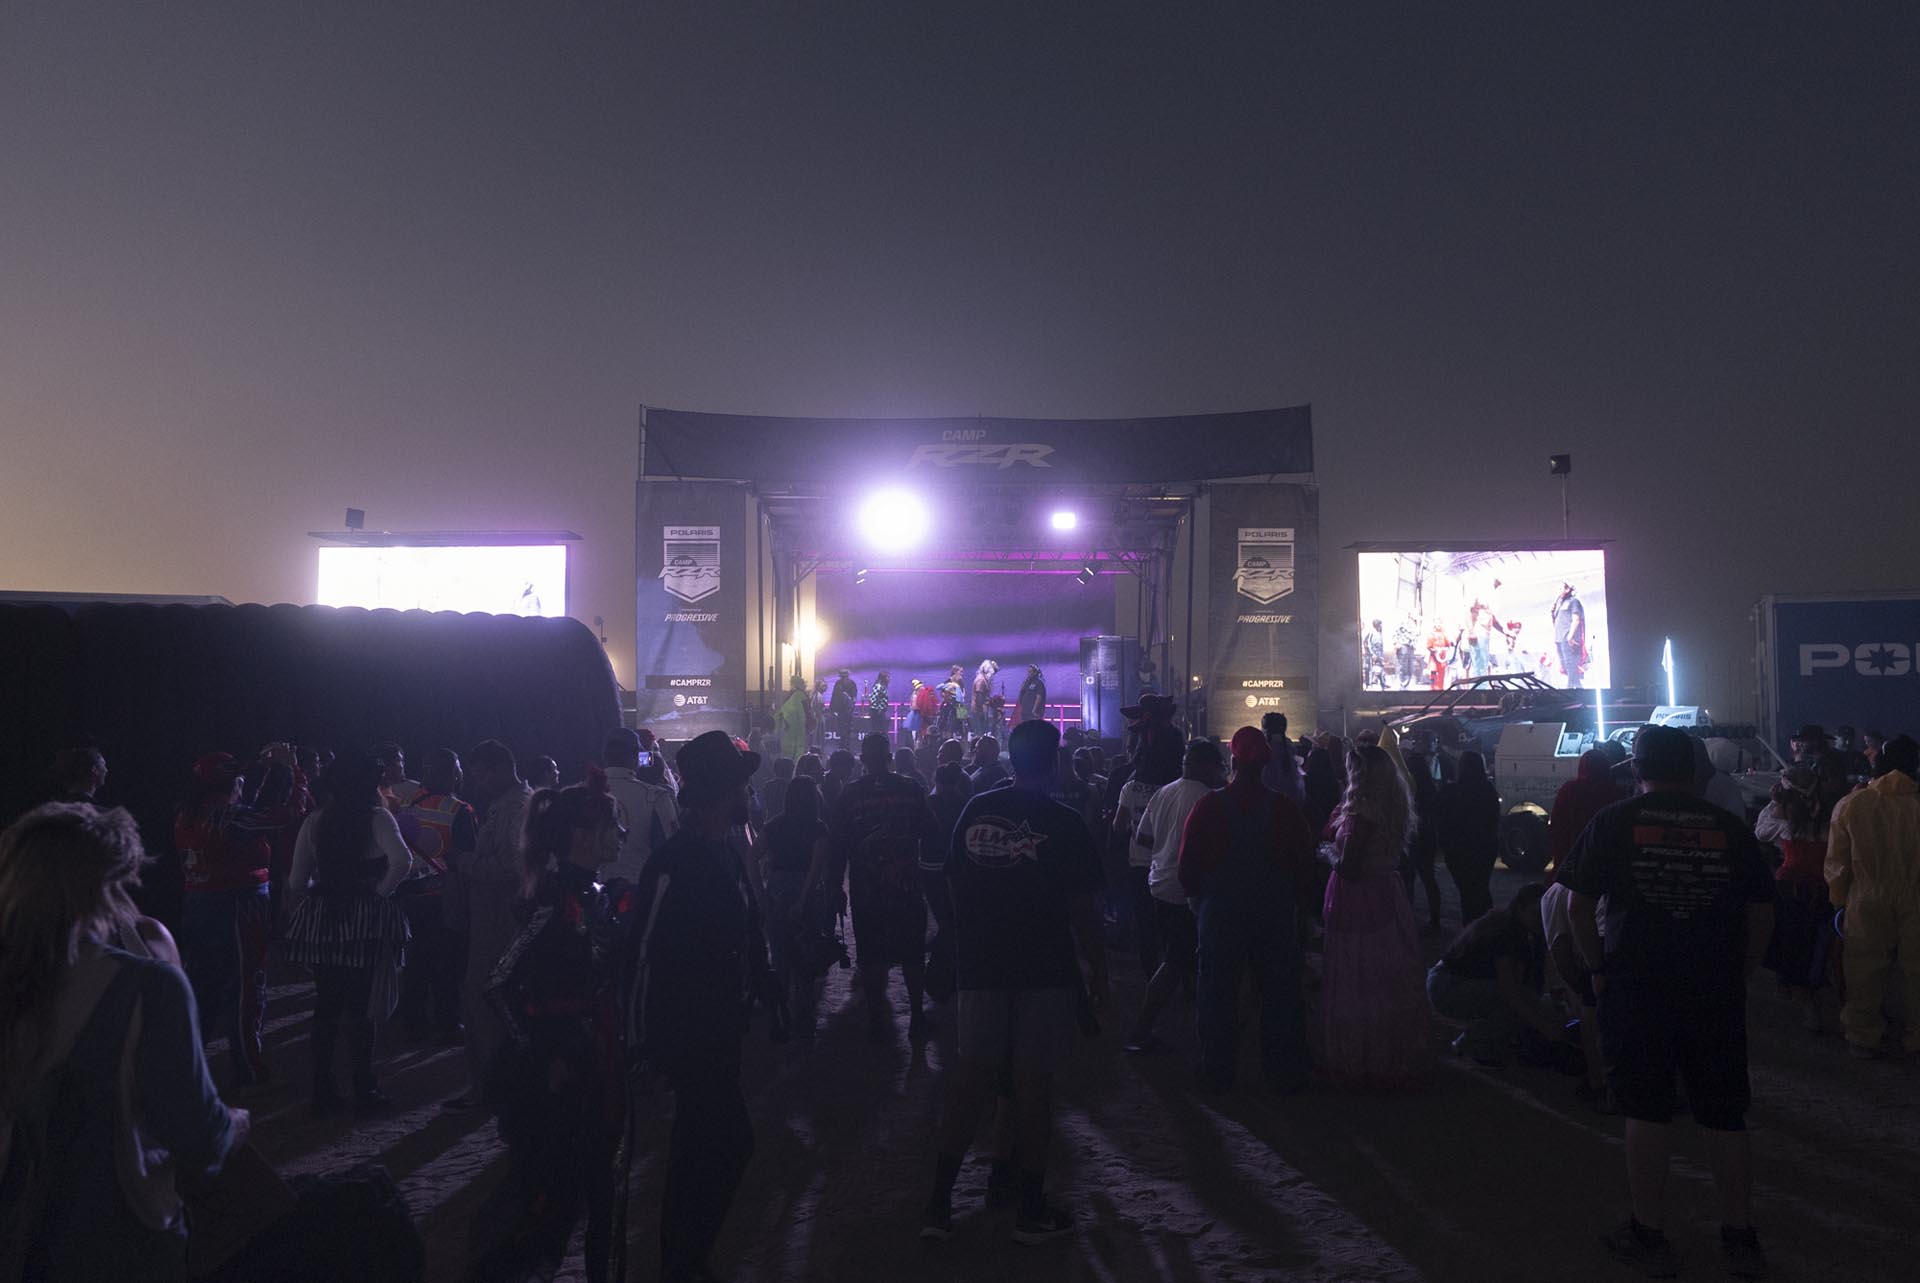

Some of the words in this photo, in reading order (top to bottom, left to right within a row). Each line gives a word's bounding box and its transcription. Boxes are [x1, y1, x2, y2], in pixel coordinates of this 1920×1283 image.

[942, 430, 987, 441] CAMP
[903, 443, 1057, 472] RZR
[658, 566, 721, 579] RZR
[1232, 567, 1296, 580] RZR
[664, 613, 718, 622] PROGRESSIVE
[1237, 615, 1292, 623] PROGRESSIVE
[1799, 642, 1920, 676] PO
[670, 679, 712, 687] #CAMPRZR
[1242, 680, 1284, 688] #CAMPRZR
[686, 696, 708, 705] AT&T
[1258, 697, 1280, 706] AT&T
